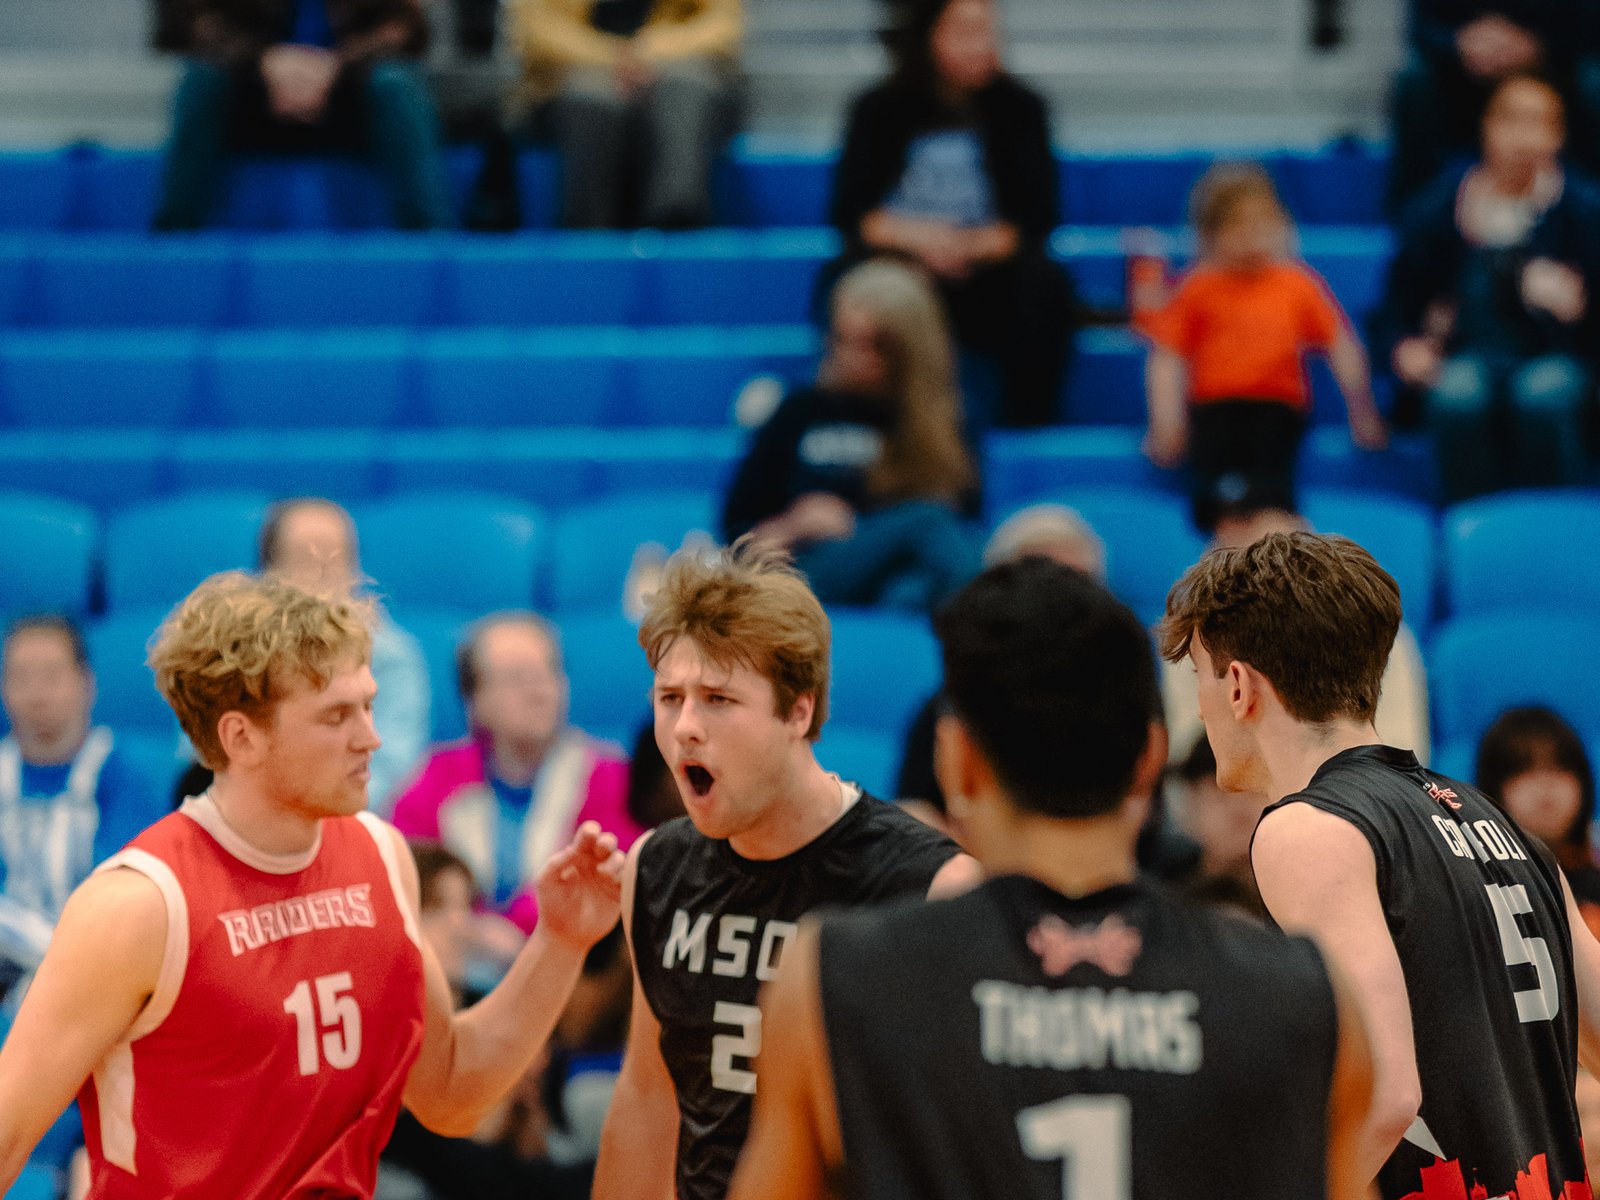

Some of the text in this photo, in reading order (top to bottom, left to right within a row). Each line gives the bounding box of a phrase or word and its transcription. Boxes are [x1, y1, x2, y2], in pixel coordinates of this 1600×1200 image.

[217, 882, 376, 957] RAIDERS
[1484, 882, 1560, 1024] 5
[282, 971, 362, 1076] 15
[711, 1000, 762, 1095] 2
[972, 979, 1202, 1075] THOMAS
